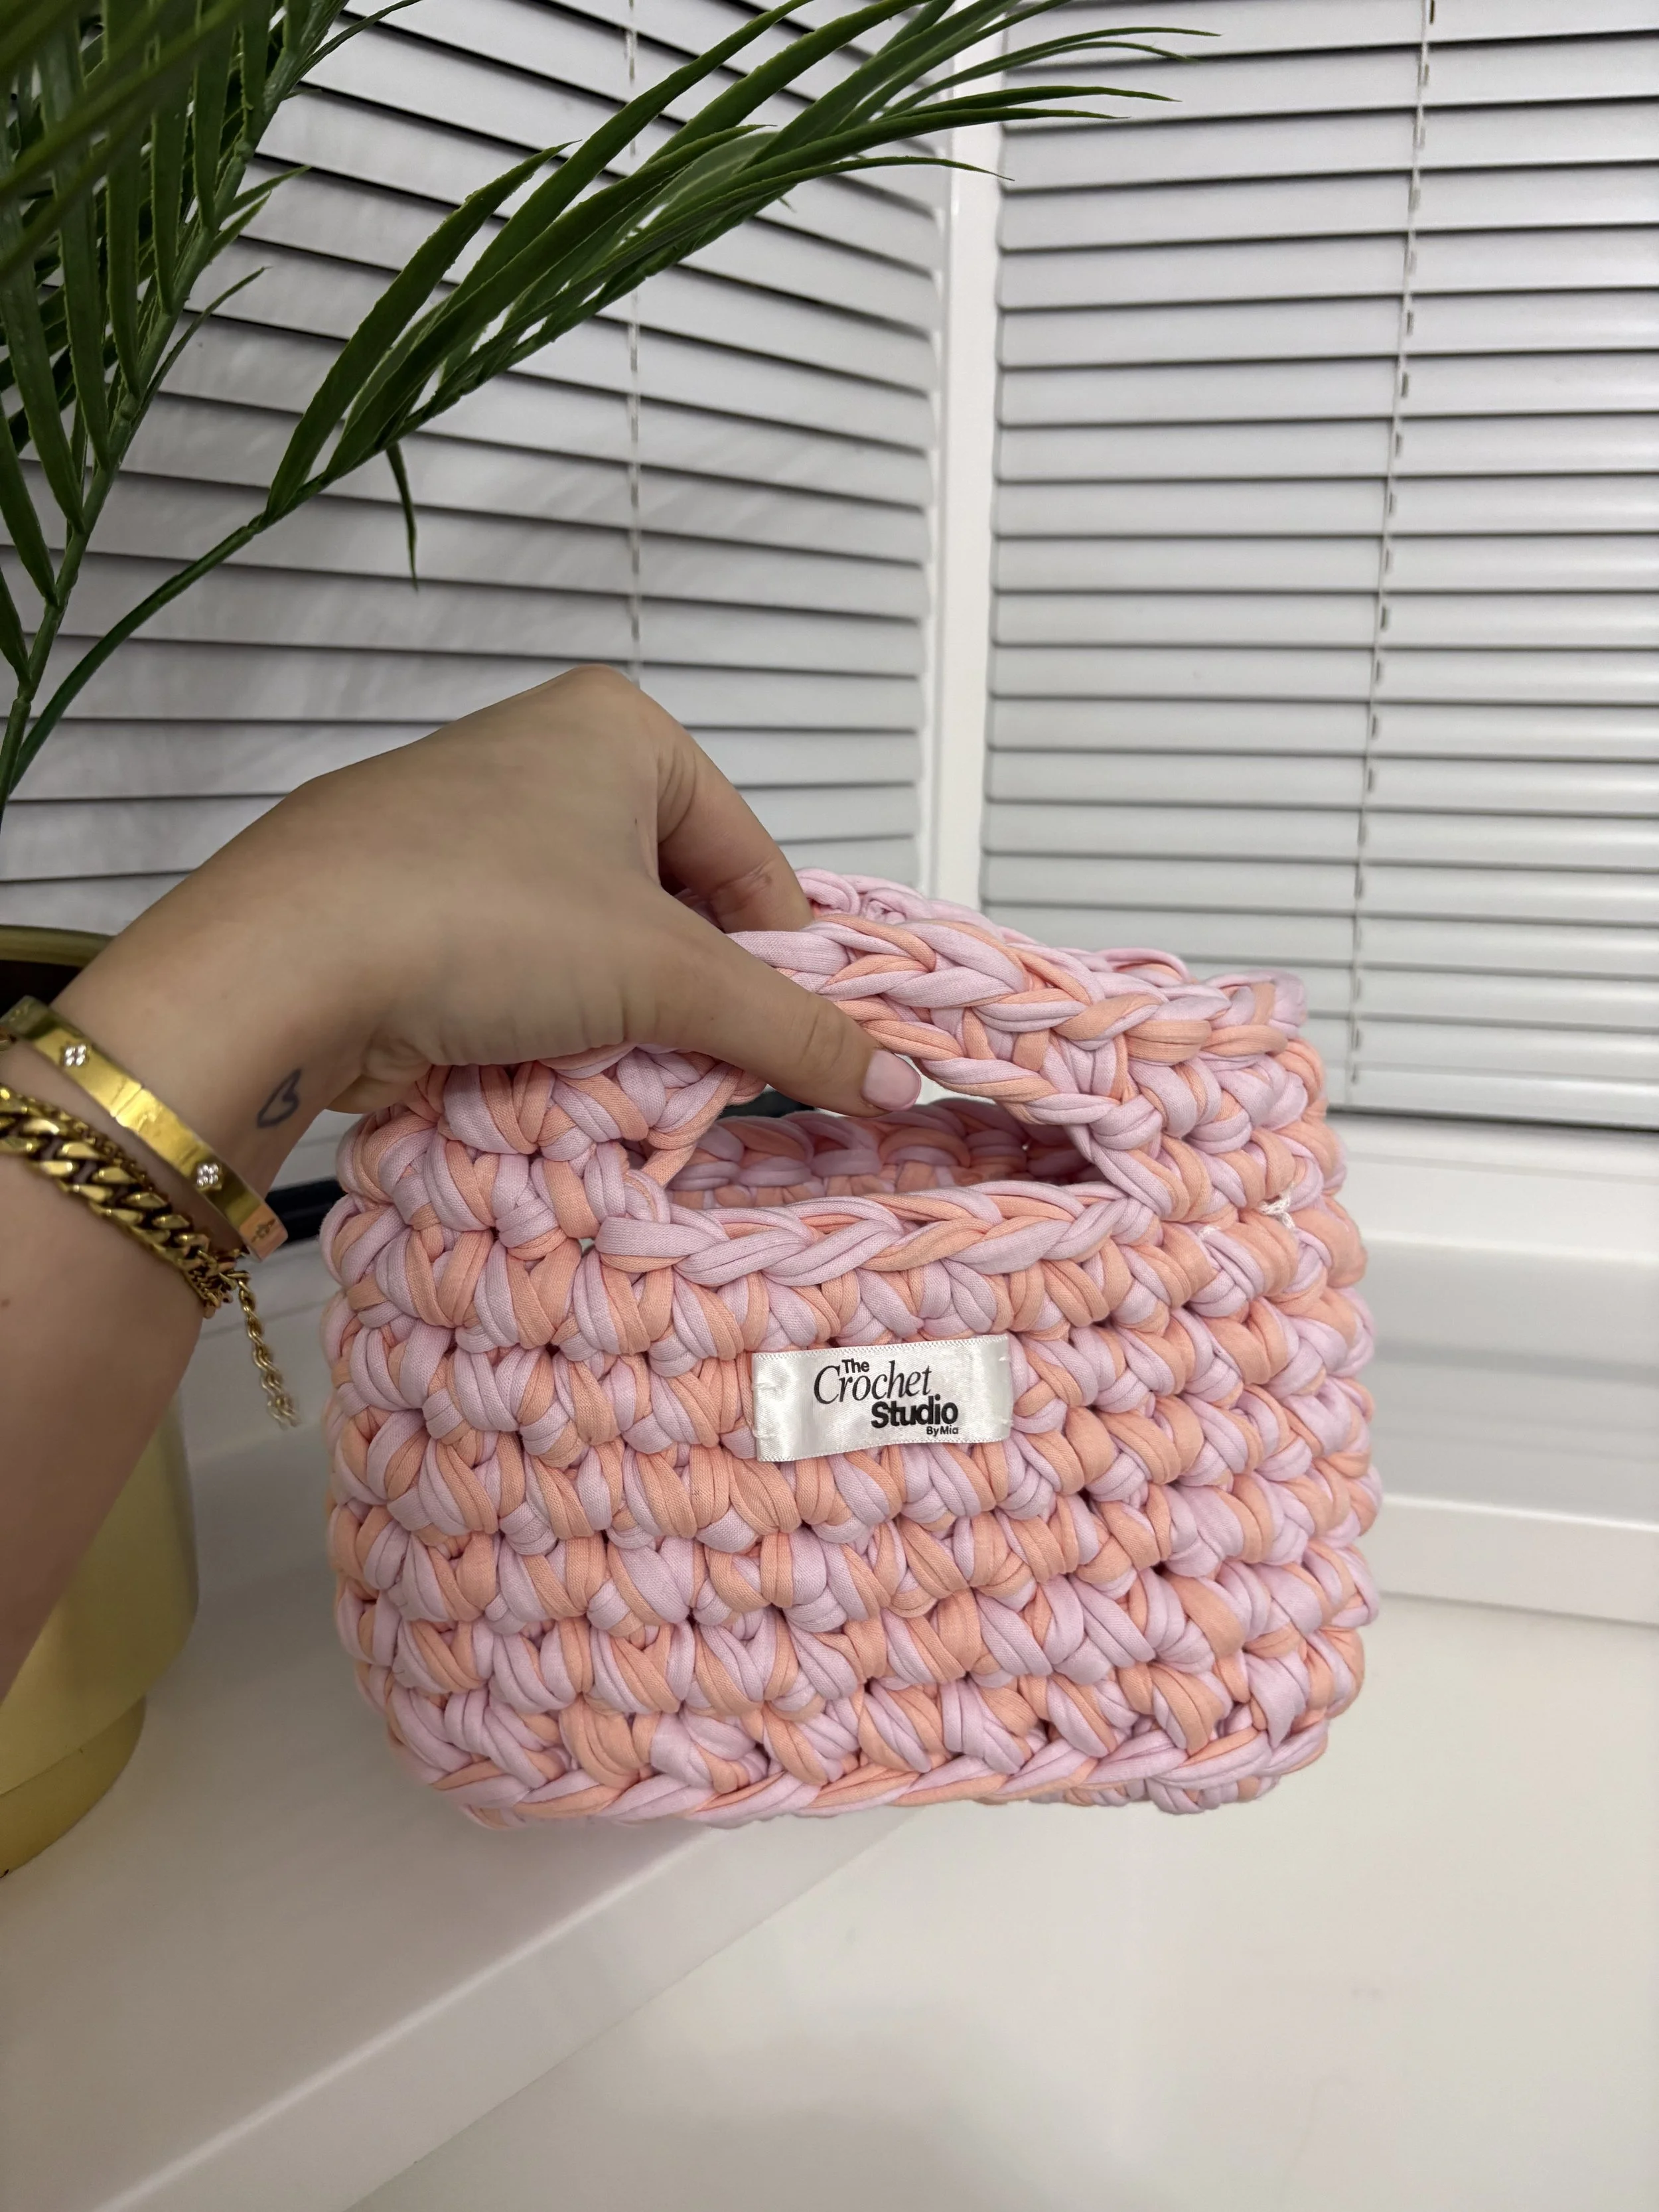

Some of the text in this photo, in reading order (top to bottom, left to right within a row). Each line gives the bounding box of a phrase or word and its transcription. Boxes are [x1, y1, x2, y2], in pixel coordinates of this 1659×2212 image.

[814, 1360, 932, 1404] Crochet
[841, 1358, 869, 1373] The
[871, 1394, 958, 1428] Studio
